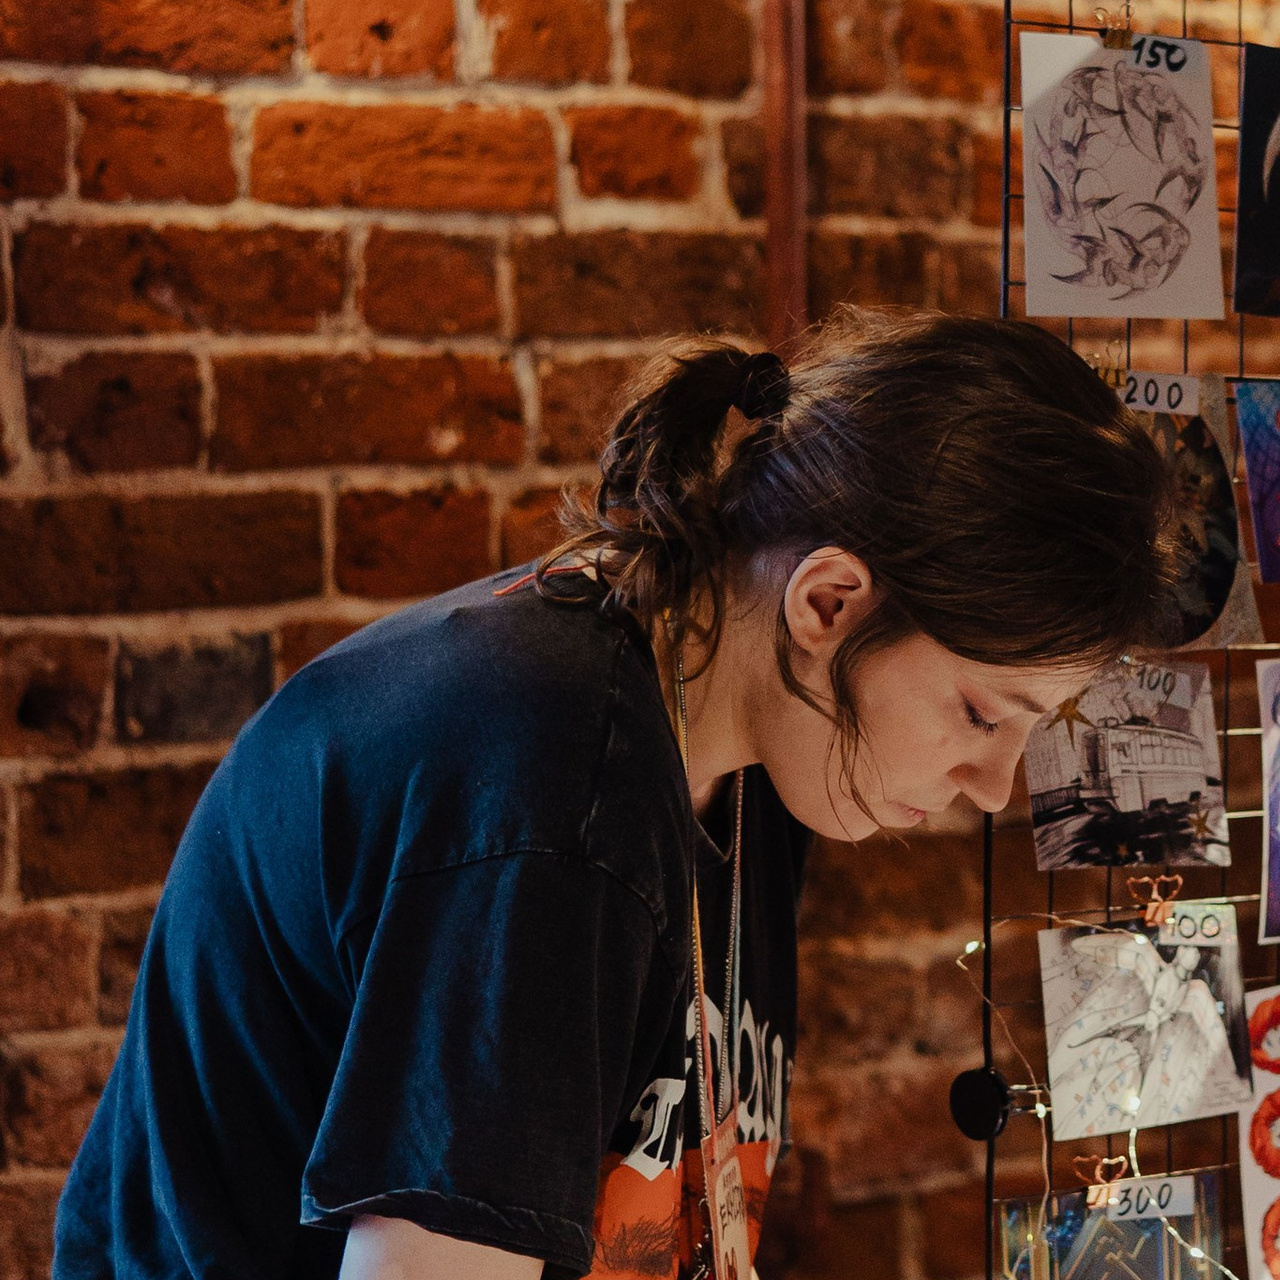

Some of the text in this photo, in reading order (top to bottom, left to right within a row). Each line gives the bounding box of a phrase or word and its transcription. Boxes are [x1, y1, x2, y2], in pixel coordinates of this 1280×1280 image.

[1132, 38, 1188, 71] 150
[1124, 376, 1184, 410] 200
[1136, 665, 1176, 696] 100
[1169, 912, 1220, 939] 100
[1117, 1183, 1173, 1216] 300
